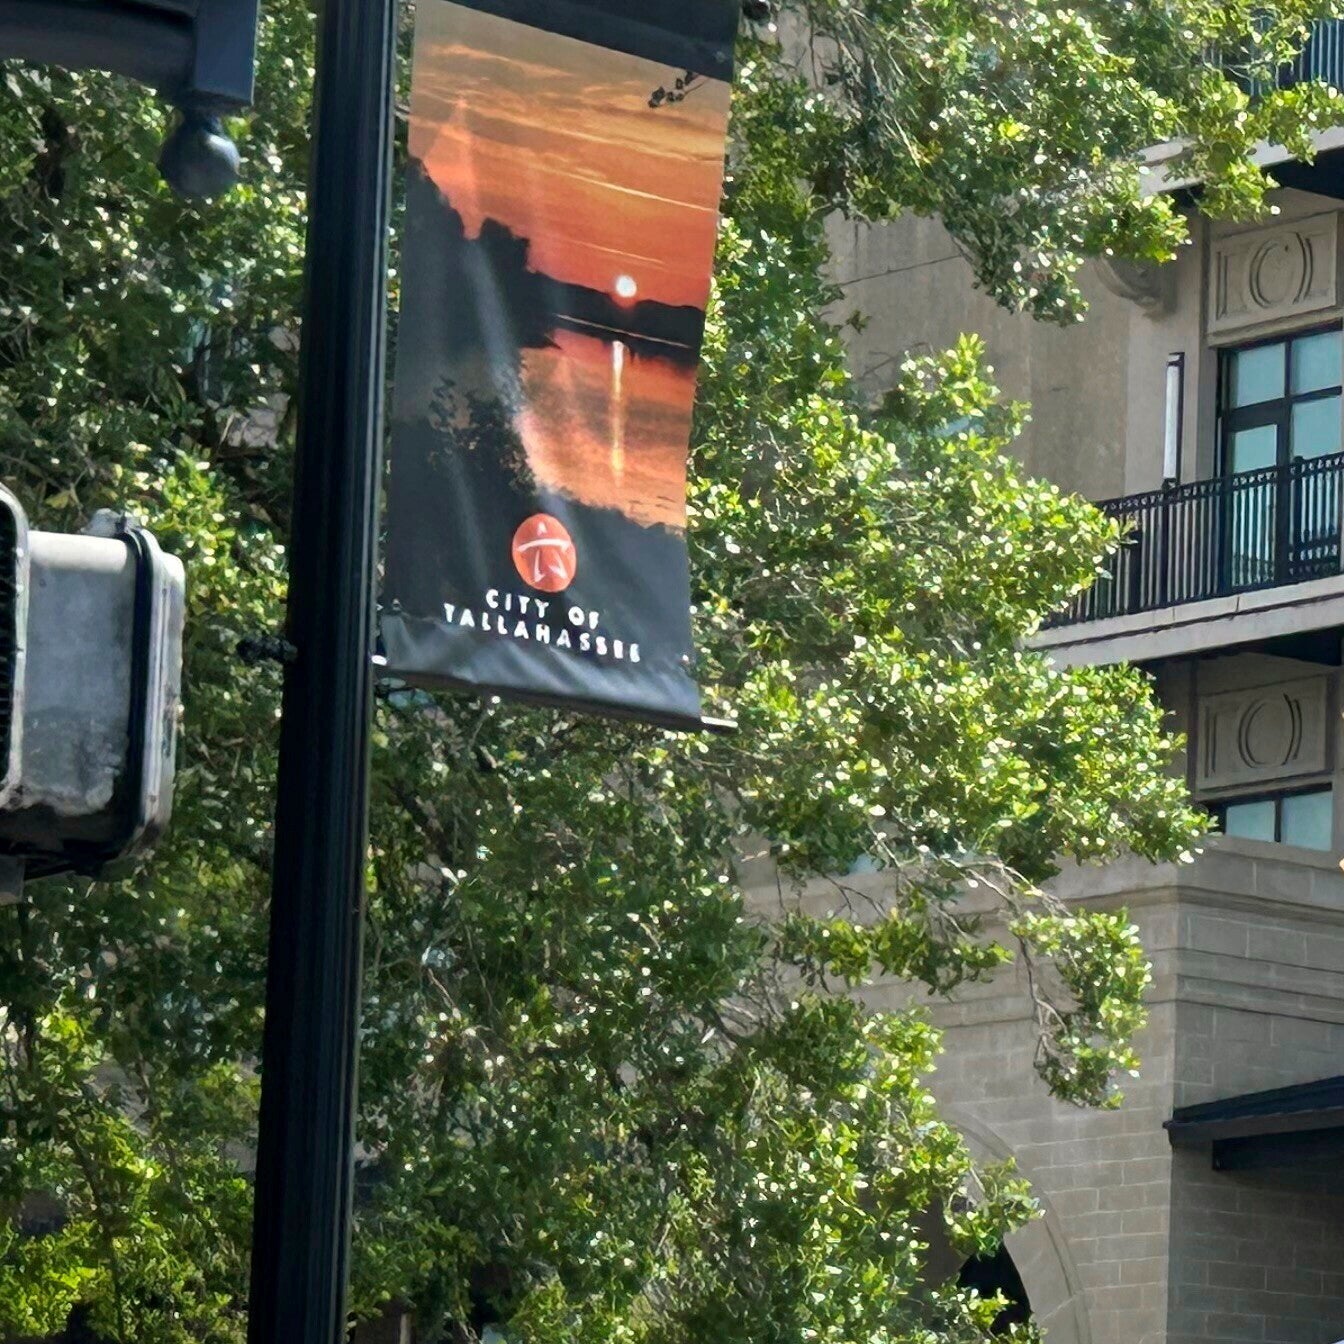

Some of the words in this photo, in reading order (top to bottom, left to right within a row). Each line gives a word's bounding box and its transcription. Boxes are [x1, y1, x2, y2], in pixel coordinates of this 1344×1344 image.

[444, 602, 641, 663] TALLAHASSEE
[486, 588, 549, 618] CITY
[568, 606, 600, 629] OF
